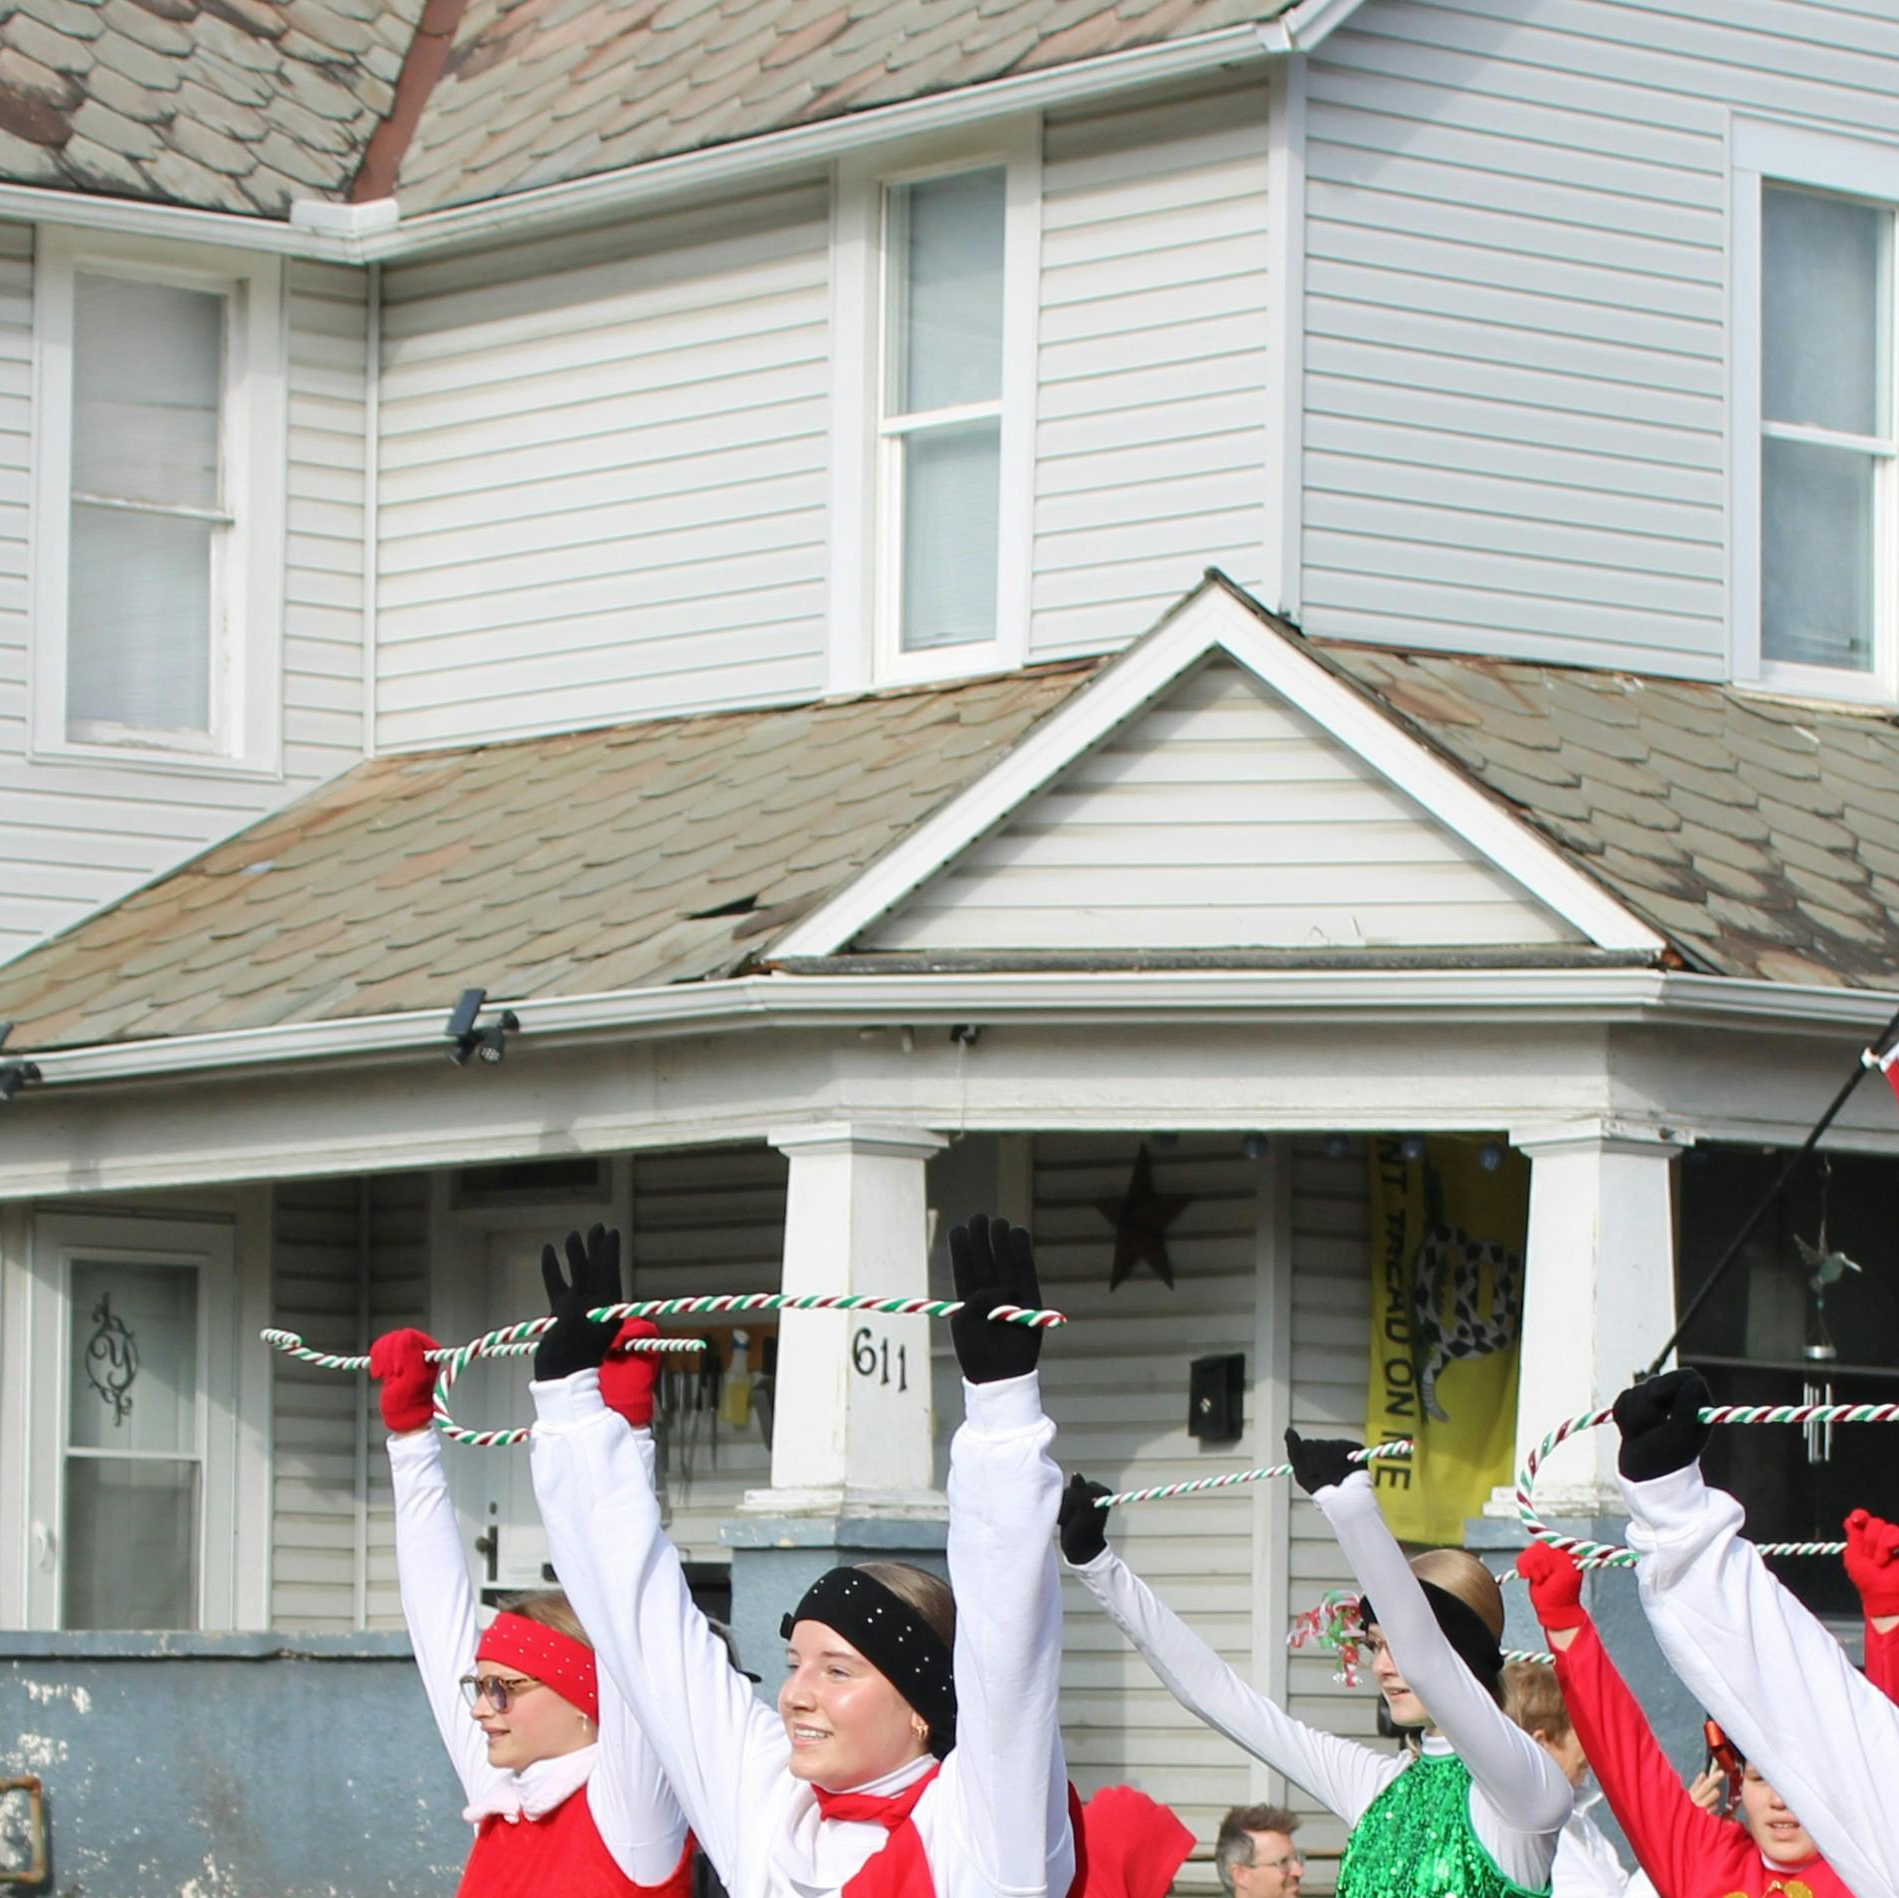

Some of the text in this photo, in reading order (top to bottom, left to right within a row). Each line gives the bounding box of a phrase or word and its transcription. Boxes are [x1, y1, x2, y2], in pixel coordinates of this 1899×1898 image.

[1385, 1209, 1412, 1344] TREAD
[852, 1327, 908, 1394] 611
[1385, 1358, 1415, 1417] ON
